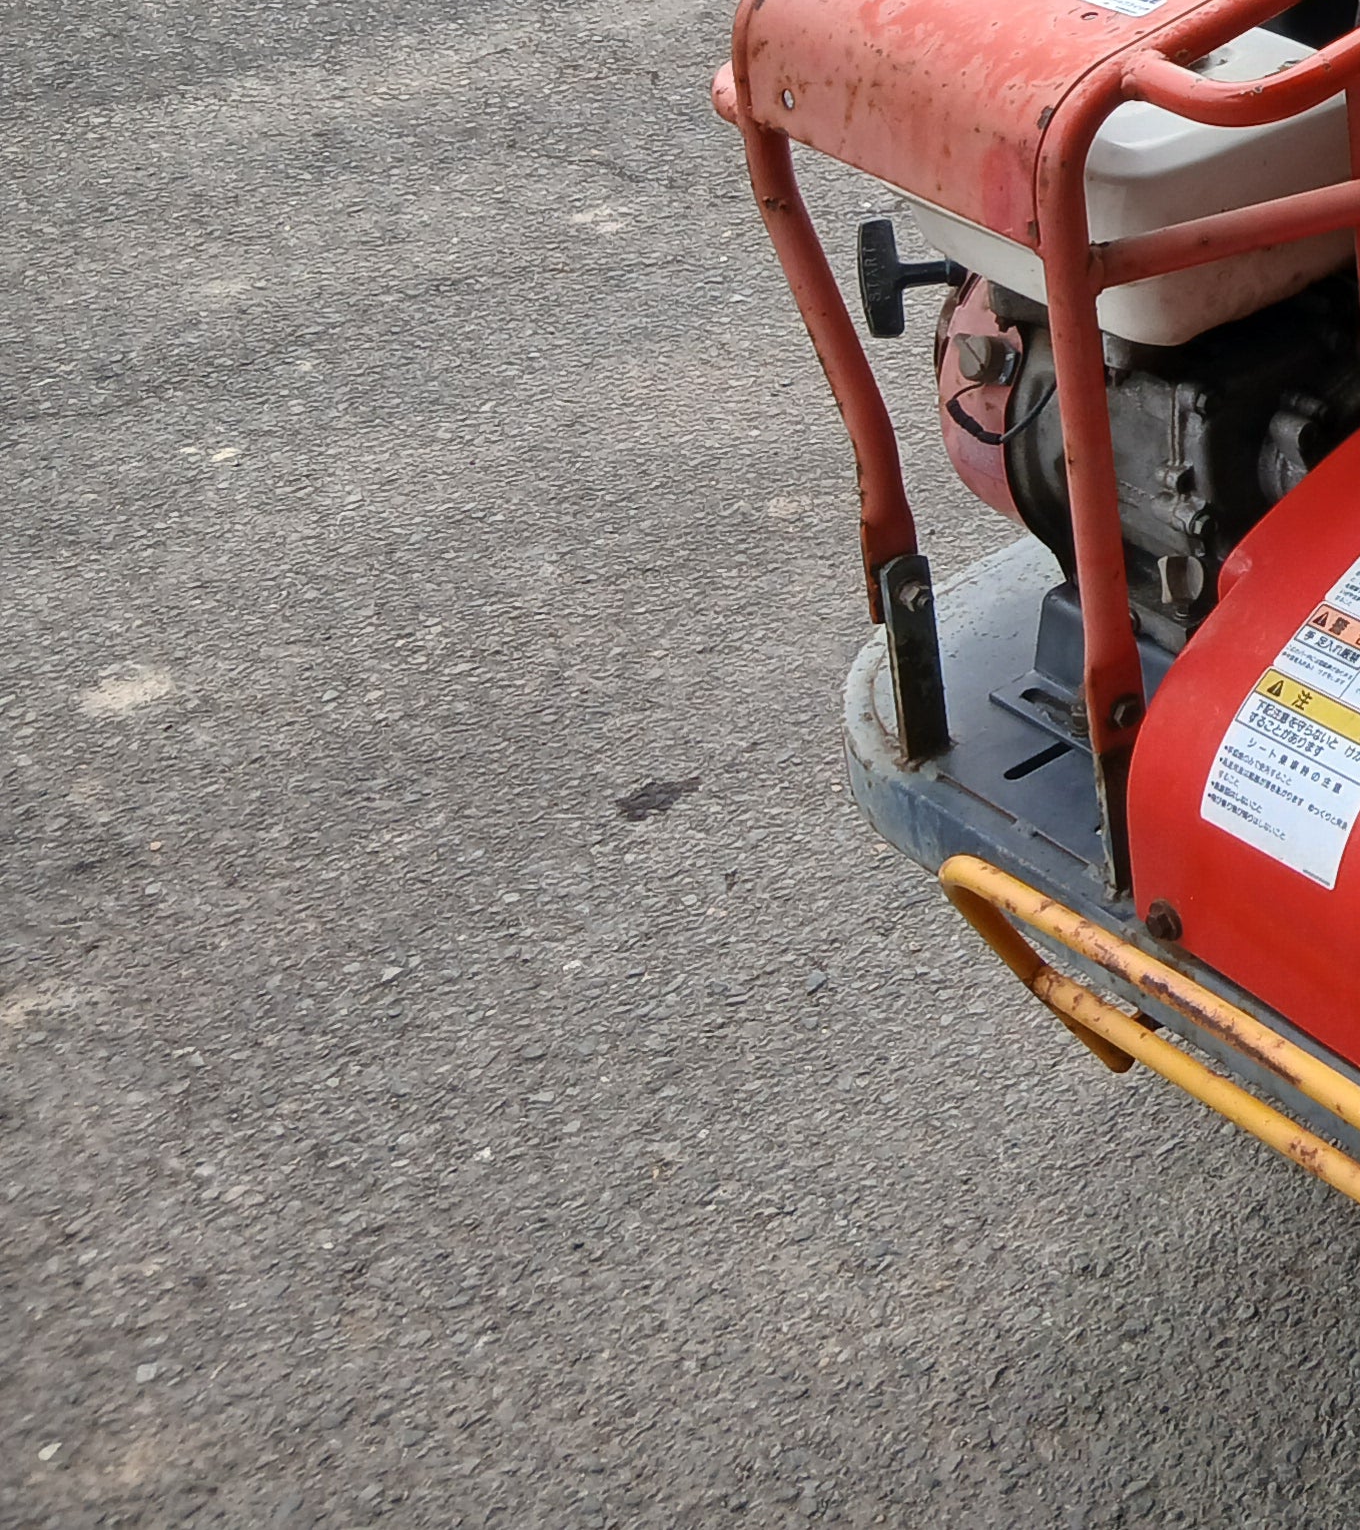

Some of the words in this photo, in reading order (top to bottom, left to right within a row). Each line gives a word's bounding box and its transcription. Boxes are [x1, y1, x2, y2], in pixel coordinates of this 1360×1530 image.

[863, 247, 880, 302] START
[1248, 711, 1325, 758] することがあります
[1257, 698, 1339, 751] 下記注意を守らないと
